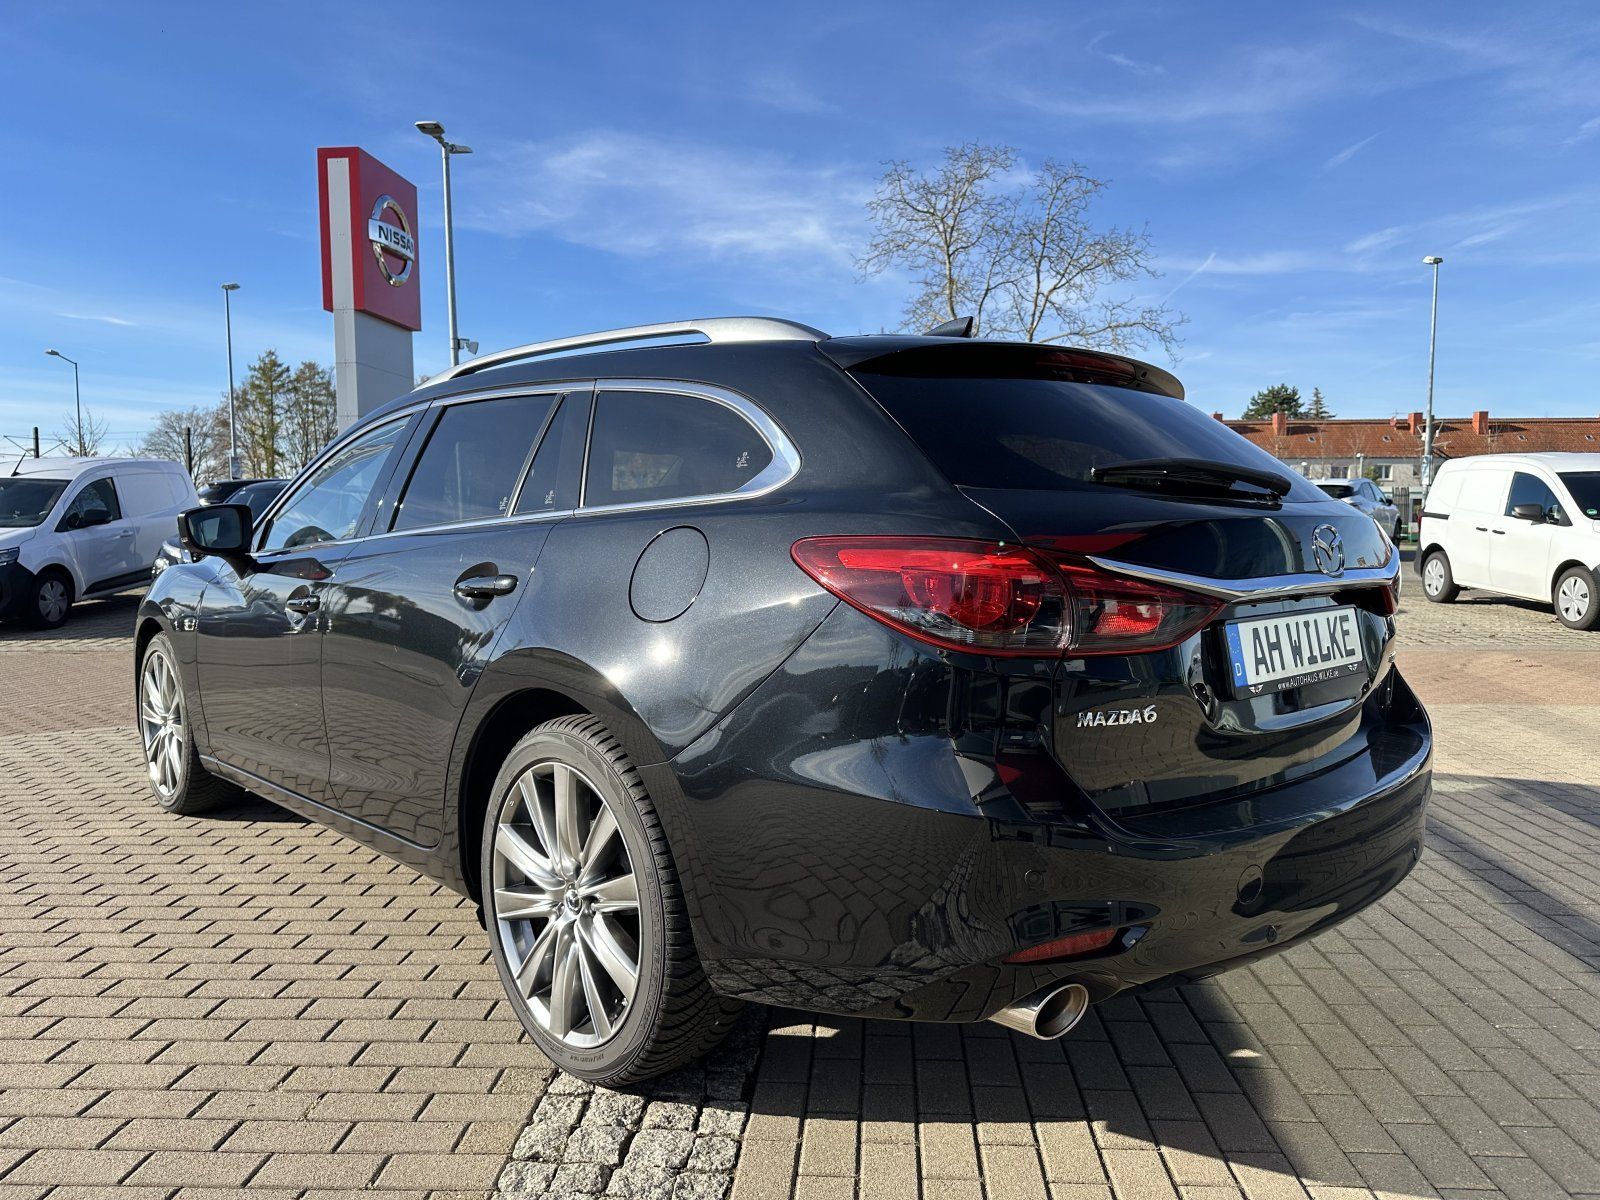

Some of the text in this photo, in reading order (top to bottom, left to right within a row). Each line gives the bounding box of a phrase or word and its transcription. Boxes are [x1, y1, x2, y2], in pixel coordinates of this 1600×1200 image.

[1252, 614, 1356, 675] AH WILKE
[1235, 663, 1242, 676] D
[1077, 704, 1157, 727] MAZDA6
